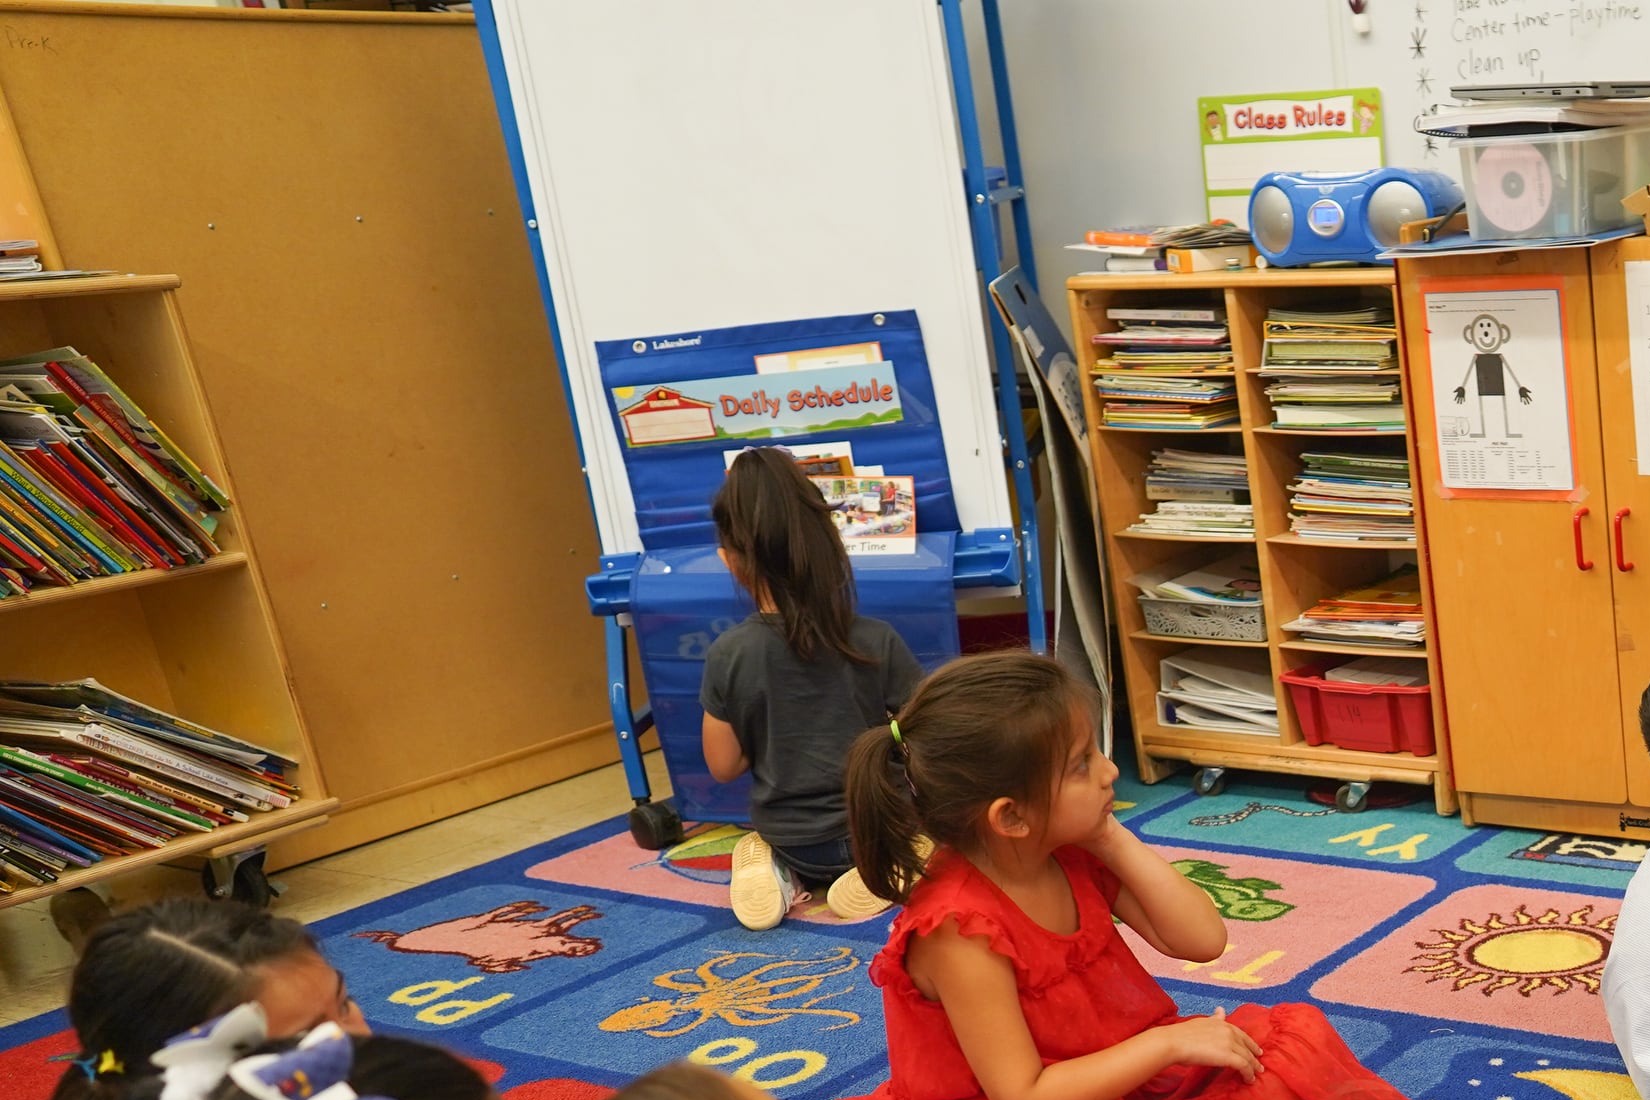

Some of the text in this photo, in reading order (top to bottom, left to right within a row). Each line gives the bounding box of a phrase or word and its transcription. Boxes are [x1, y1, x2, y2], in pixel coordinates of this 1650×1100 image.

[1450, 18, 1506, 42] Center
[1457, 49, 1504, 80] clean
[1234, 102, 1346, 129] Class Rules
[652, 336, 700, 351] Lakeshore
[719, 377, 893, 418] Daily Schedule
[11, 470, 29, 489] What
[66, 515, 85, 533] World
[860, 541, 887, 552] Time
[182, 764, 201, 776] School
[1328, 823, 1430, 860] Yy
[386, 975, 515, 1025] Pp
[688, 1036, 828, 1090] Oo
